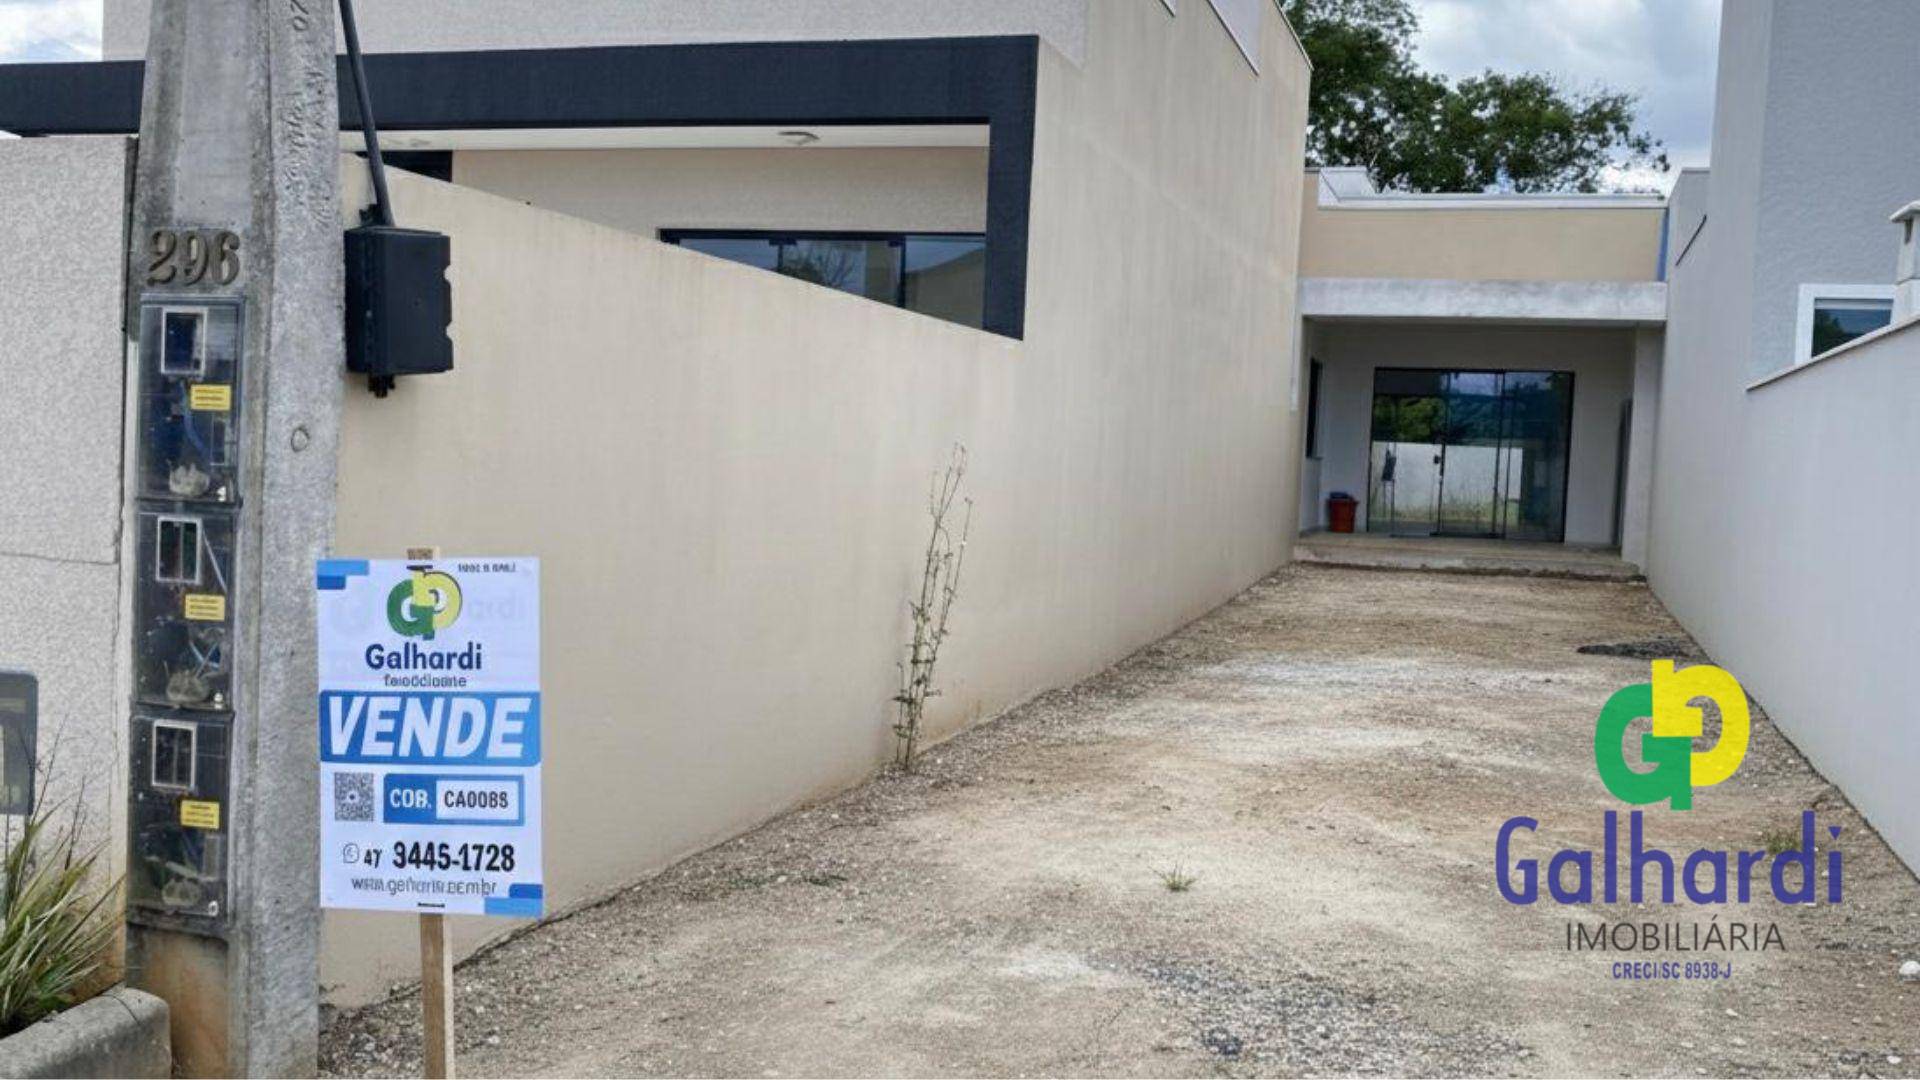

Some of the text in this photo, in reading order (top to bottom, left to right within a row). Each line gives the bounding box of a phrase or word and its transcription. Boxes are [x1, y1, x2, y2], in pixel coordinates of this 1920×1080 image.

[147, 229, 241, 286] 296
[365, 641, 483, 671] Galhardi
[328, 696, 531, 758] VENDE
[363, 840, 516, 872] 47 3445-1728
